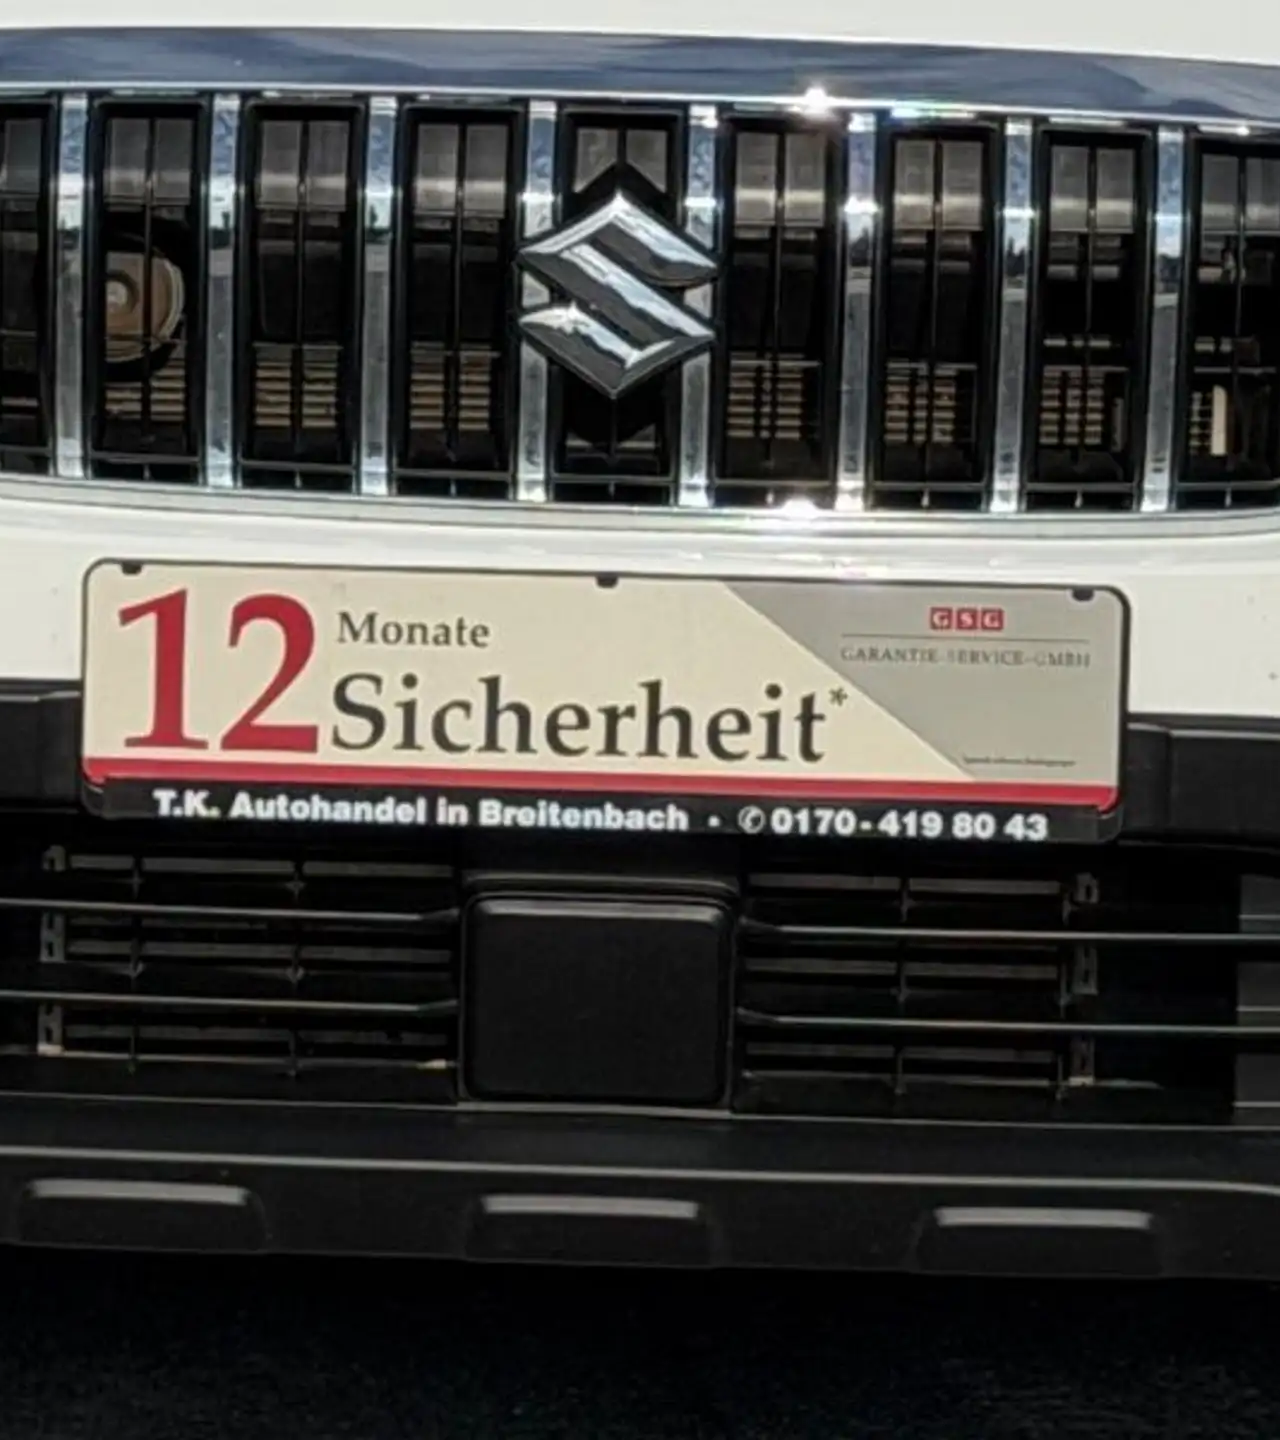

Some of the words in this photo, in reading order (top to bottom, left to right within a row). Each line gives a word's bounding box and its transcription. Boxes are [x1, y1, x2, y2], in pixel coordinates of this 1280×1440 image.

[336, 610, 490, 648] Monate
[119, 588, 319, 753] 12
[152, 789, 218, 818] T.K.
[230, 791, 427, 826] Autohandel
[436, 796, 468, 826] in
[479, 798, 688, 832] Breitenbach
[951, 812, 995, 839] 80
[1004, 814, 1048, 841] 43
